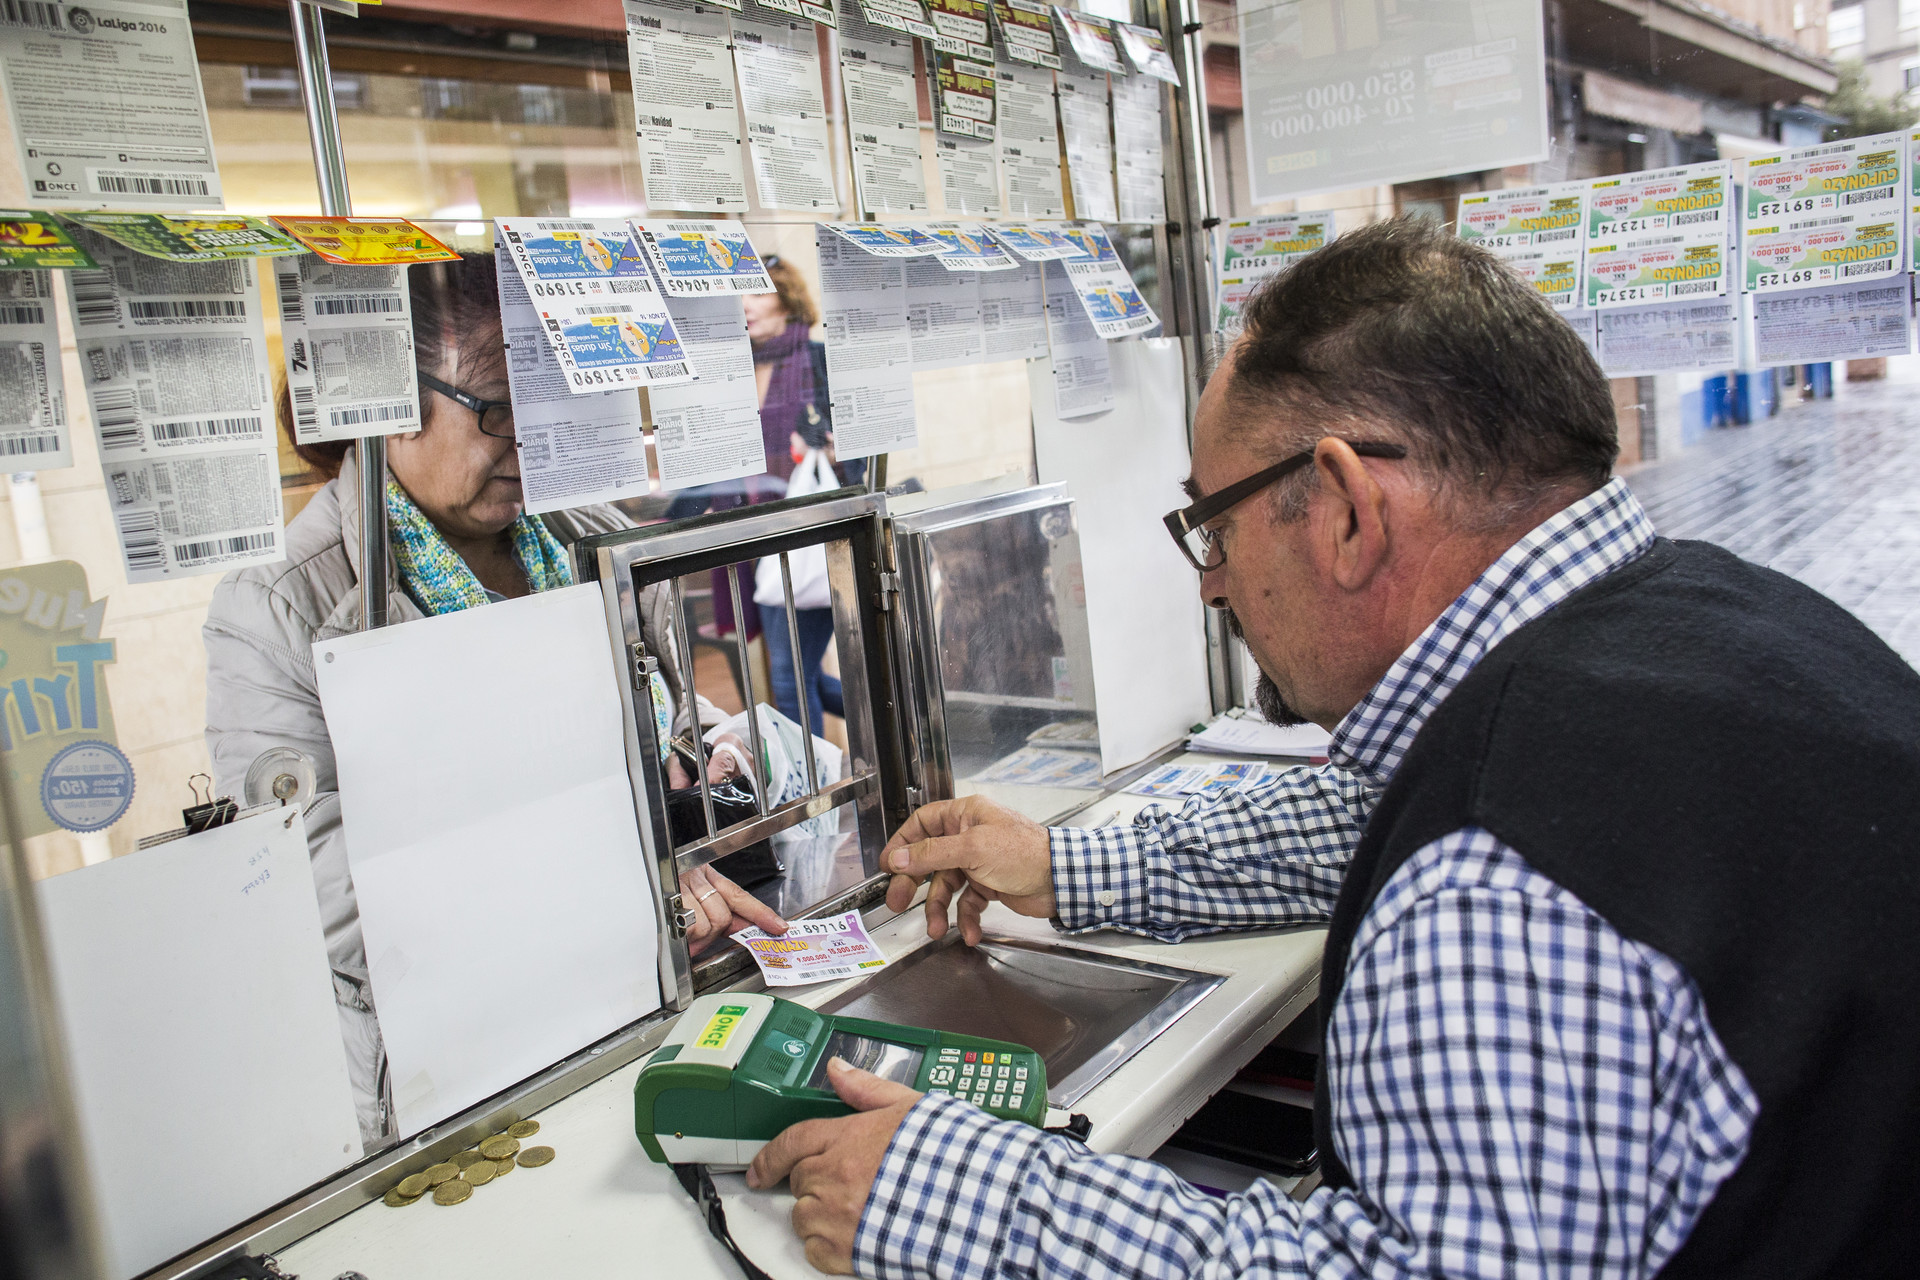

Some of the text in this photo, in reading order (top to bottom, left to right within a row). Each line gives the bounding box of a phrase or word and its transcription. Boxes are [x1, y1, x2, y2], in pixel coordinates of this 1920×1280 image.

[97, 17, 167, 33] LaLiga 2016
[641, 15, 661, 28] Navidad
[652, 116, 672, 128] Navidad
[1749, 159, 1772, 167] ONCE
[1810, 163, 1847, 173] 9.000.000
[1858, 158, 1895, 169] 800.000
[1758, 174, 1803, 186] 15.000.000
[1822, 168, 1897, 190] CUPONAZO
[48, 183, 77, 191] ONCE
[1645, 187, 1677, 196] 9.000.000
[1599, 196, 1638, 207] 15.000.000
[1655, 193, 1722, 212] CUPONAZO
[1761, 199, 1813, 215] 89125
[1520, 212, 1580, 229] CUPONAZO
[1601, 220, 1646, 234] 12374
[193, 229, 262, 241] SUERTE
[1808, 234, 1845, 245] 9.000.000
[1856, 230, 1894, 241] 800.000
[210, 236, 270, 247] RACHA
[1273, 238, 1323, 252] CUPONAZO
[1756, 245, 1801, 256] 15.000.000
[1821, 241, 1896, 262] CUPONAZO
[516, 246, 535, 277] ONCE
[532, 256, 574, 265] Sin dudas
[650, 244, 668, 274] ONCE
[688, 254, 700, 263] Sin
[1233, 258, 1267, 269] 93451
[1642, 254, 1674, 263] 9.000.000
[1596, 263, 1636, 274] 15.000.000
[1653, 262, 1720, 281] CUPONAZO
[1760, 270, 1812, 286] 89125
[533, 282, 585, 297] 31890
[588, 281, 600, 289] 007
[668, 279, 710, 292] 40465
[1600, 288, 1644, 302] 12374
[510, 340, 537, 348] DIARIO
[571, 341, 612, 352] Sin dudas
[554, 334, 573, 366] ONCE
[625, 367, 637, 375] 006
[573, 368, 624, 386] 31890
[658, 420, 682, 429] DIARIO
[522, 438, 549, 447] DIARIO
[803, 921, 846, 934] 89716
[750, 940, 809, 953] CUPONAZO
[827, 944, 864, 955] 15.000.000
[796, 953, 827, 963] 9.000.000
[866, 960, 886, 968] ONCE
[703, 1016, 733, 1046] ONCE
